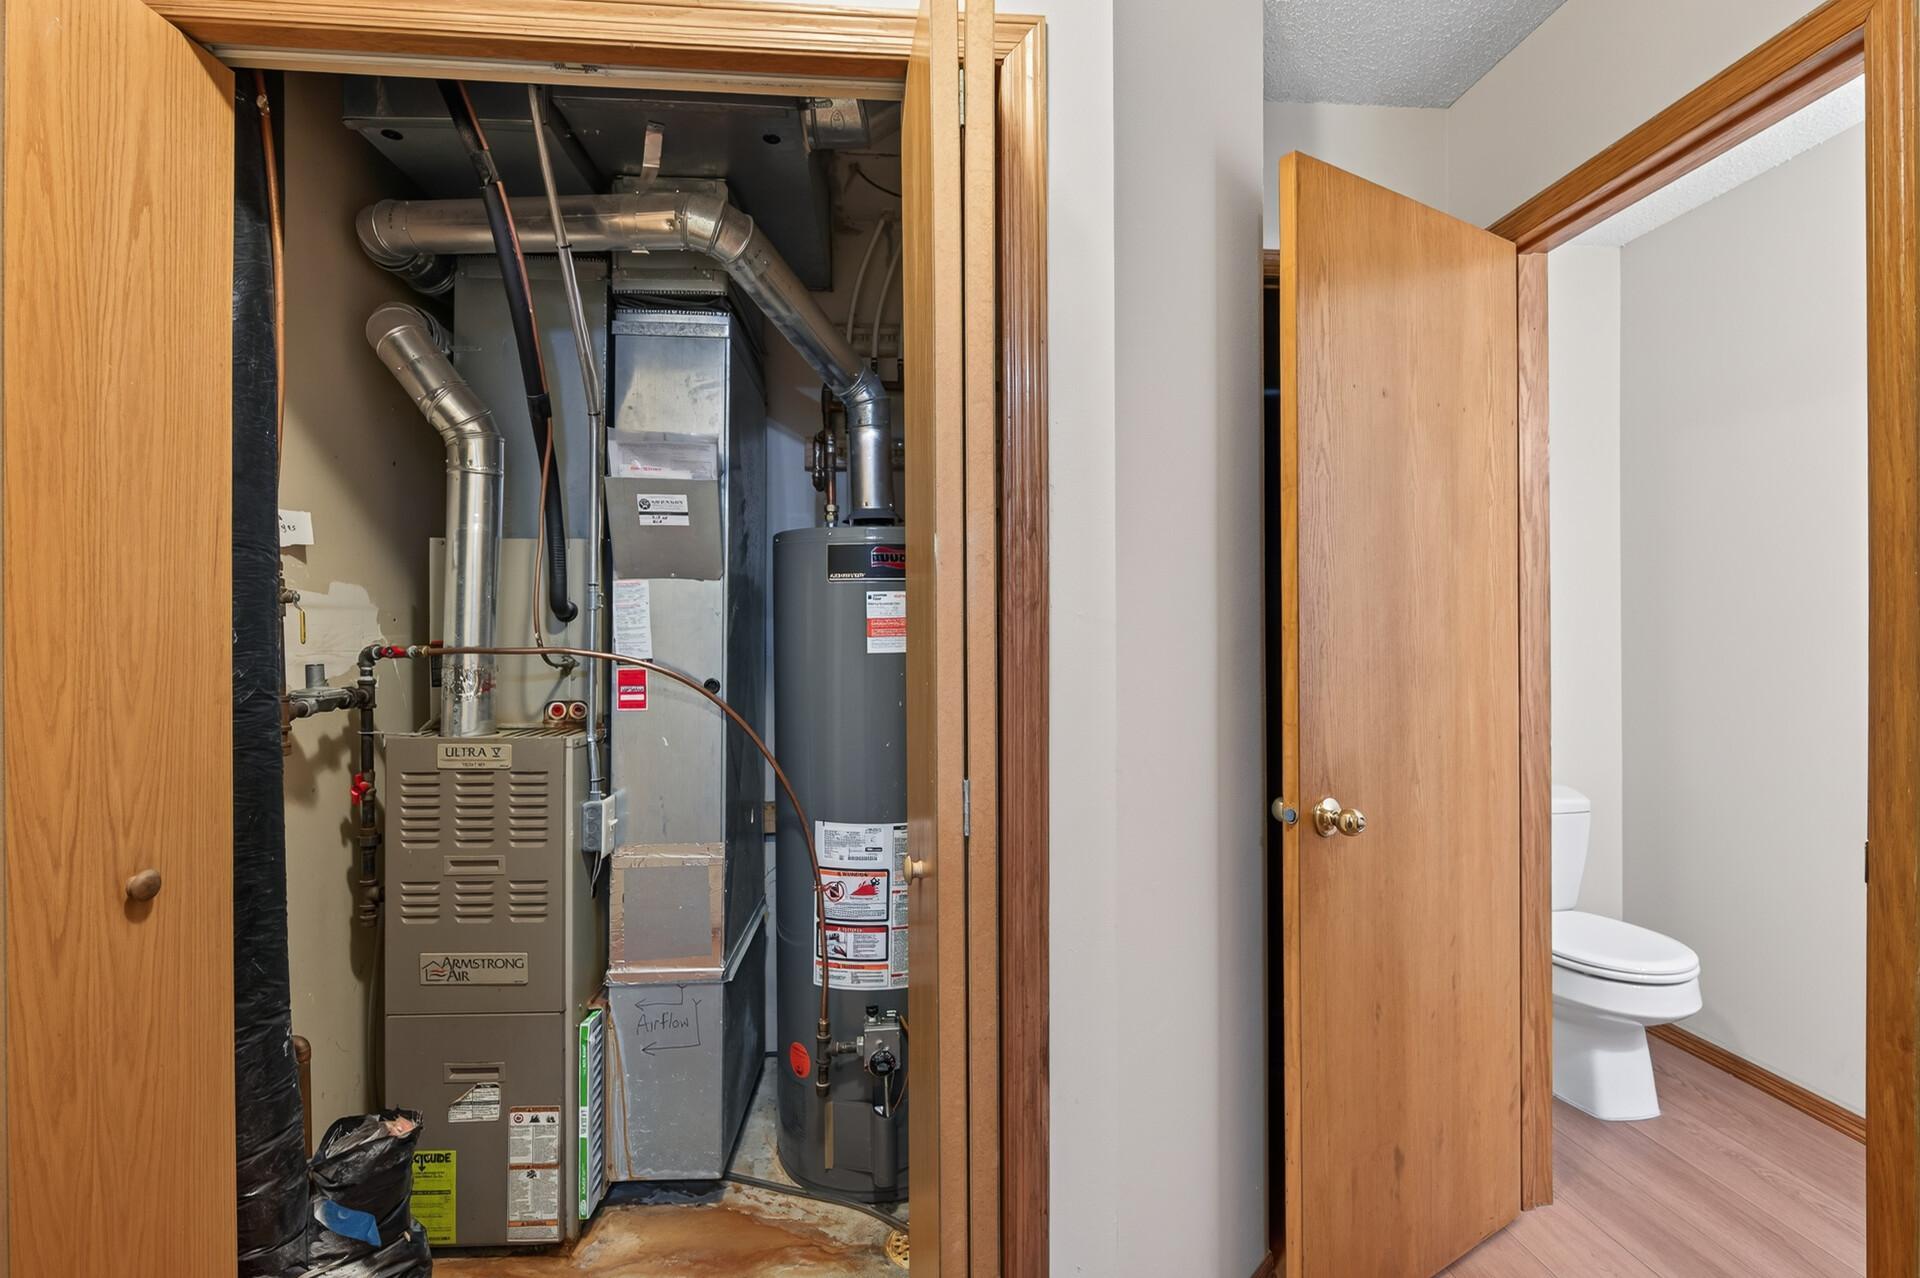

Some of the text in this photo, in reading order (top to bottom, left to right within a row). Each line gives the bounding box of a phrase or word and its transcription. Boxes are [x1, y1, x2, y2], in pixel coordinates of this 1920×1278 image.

[445, 747, 487, 757] ULTRA
[442, 957, 524, 969] ARMSTRONG
[446, 969, 470, 982] AIR
[636, 1012, 689, 1035] Airflow
